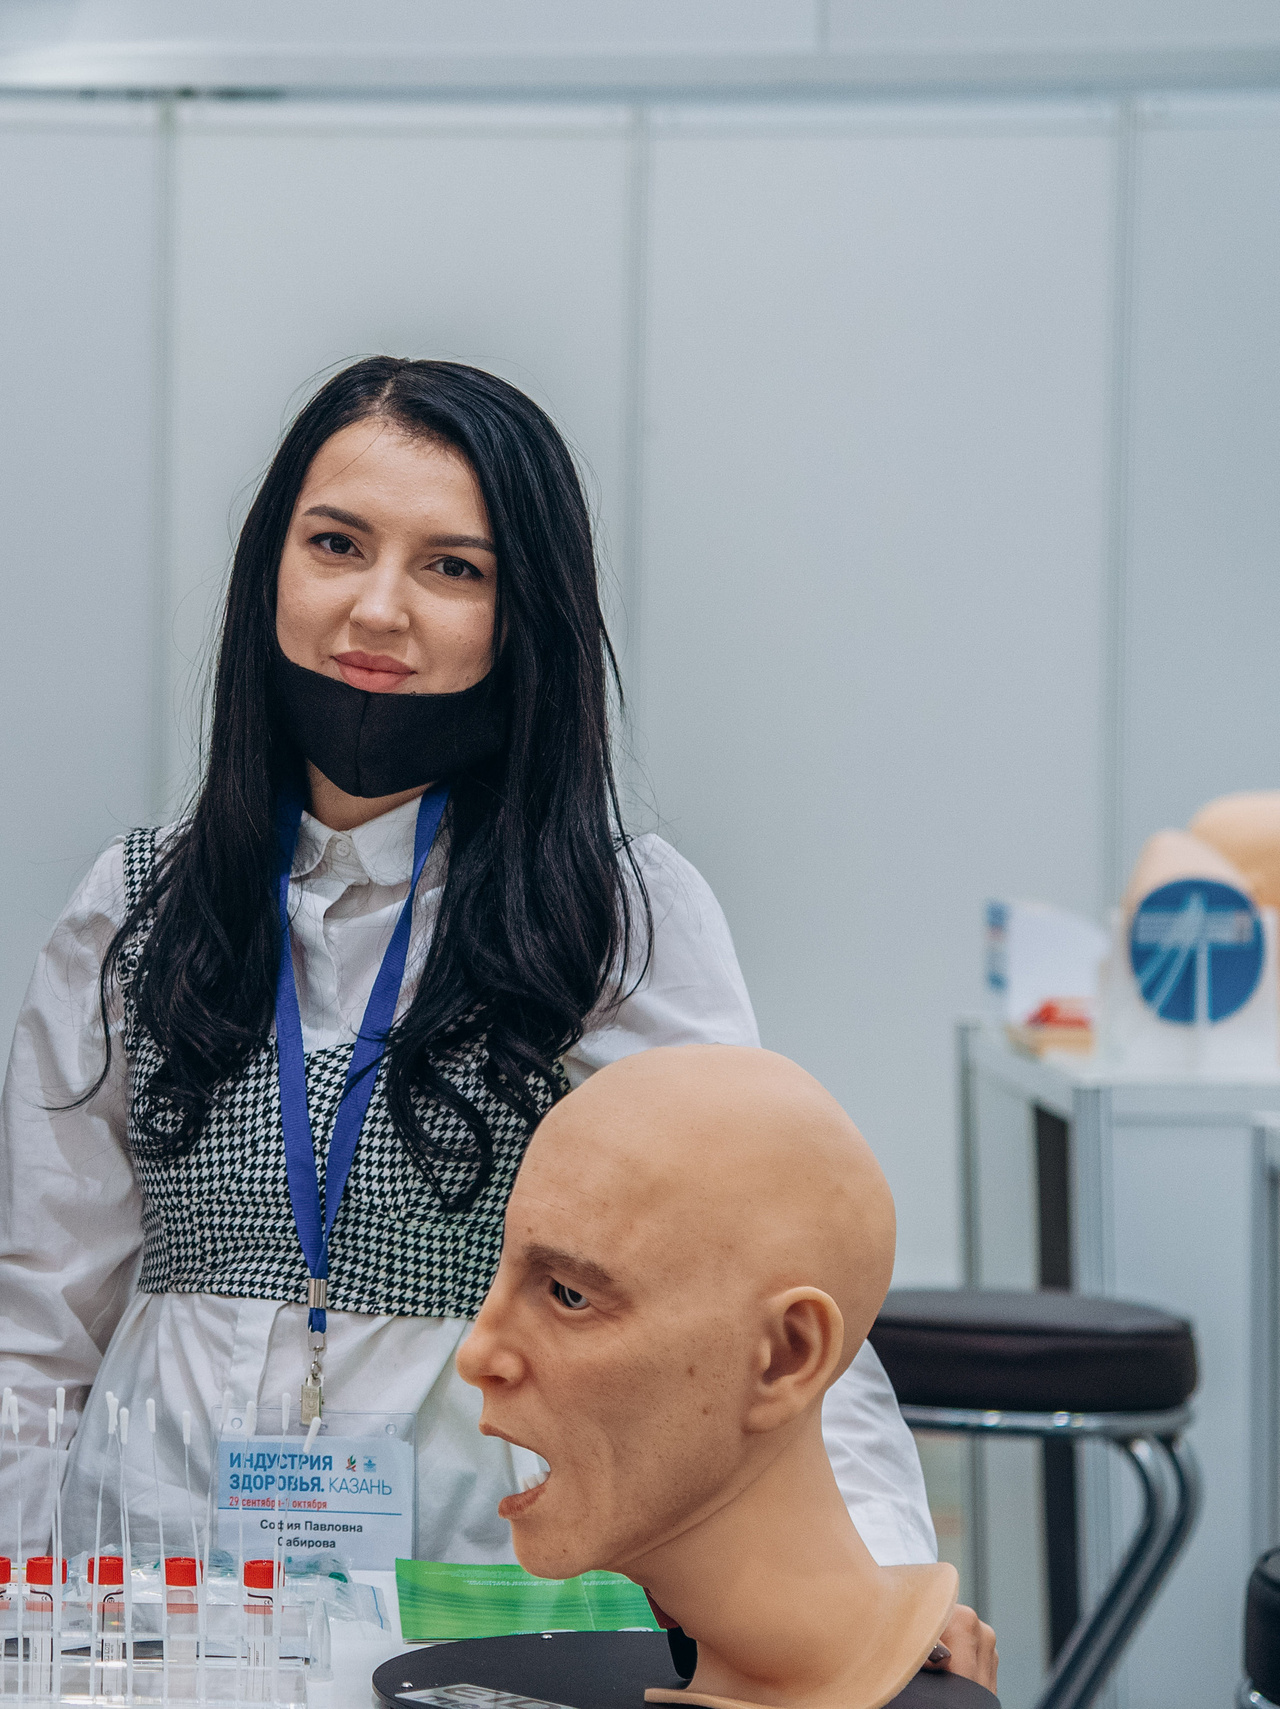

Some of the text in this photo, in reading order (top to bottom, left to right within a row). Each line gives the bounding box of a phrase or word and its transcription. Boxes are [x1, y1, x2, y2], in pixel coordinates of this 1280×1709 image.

[229, 1452, 333, 1472] ИНДУСТРИЯ
[229, 1473, 393, 1496] ЗДОРОВЬЯ. КАЗАНЬ
[229, 1496, 239, 1507] 29
[292, 1498, 328, 1511] октября
[304, 1520, 363, 1533] Павловна
[277, 1536, 336, 1549] Сабирова
